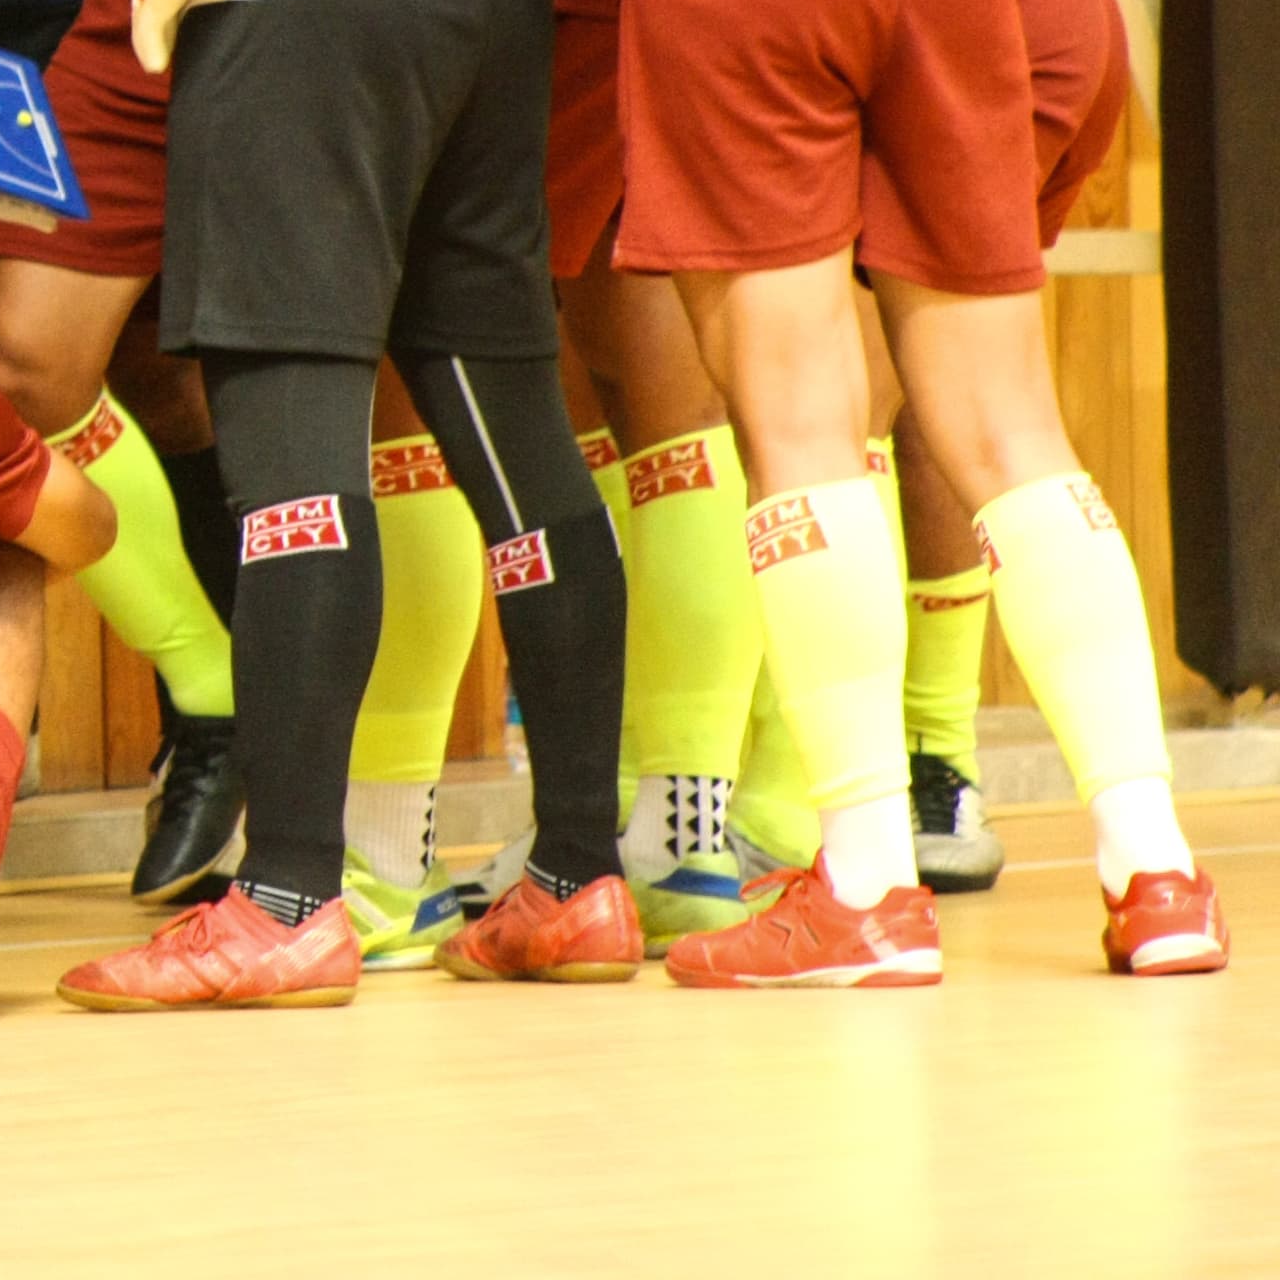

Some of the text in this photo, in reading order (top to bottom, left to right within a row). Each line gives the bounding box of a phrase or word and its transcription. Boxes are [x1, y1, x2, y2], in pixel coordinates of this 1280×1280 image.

[633, 464, 699, 501] CTY
[251, 501, 325, 531] KTM
[250, 522, 328, 553] CTY
[752, 522, 812, 567] CTY
[492, 540, 532, 566] TM
[495, 560, 534, 589] TY
